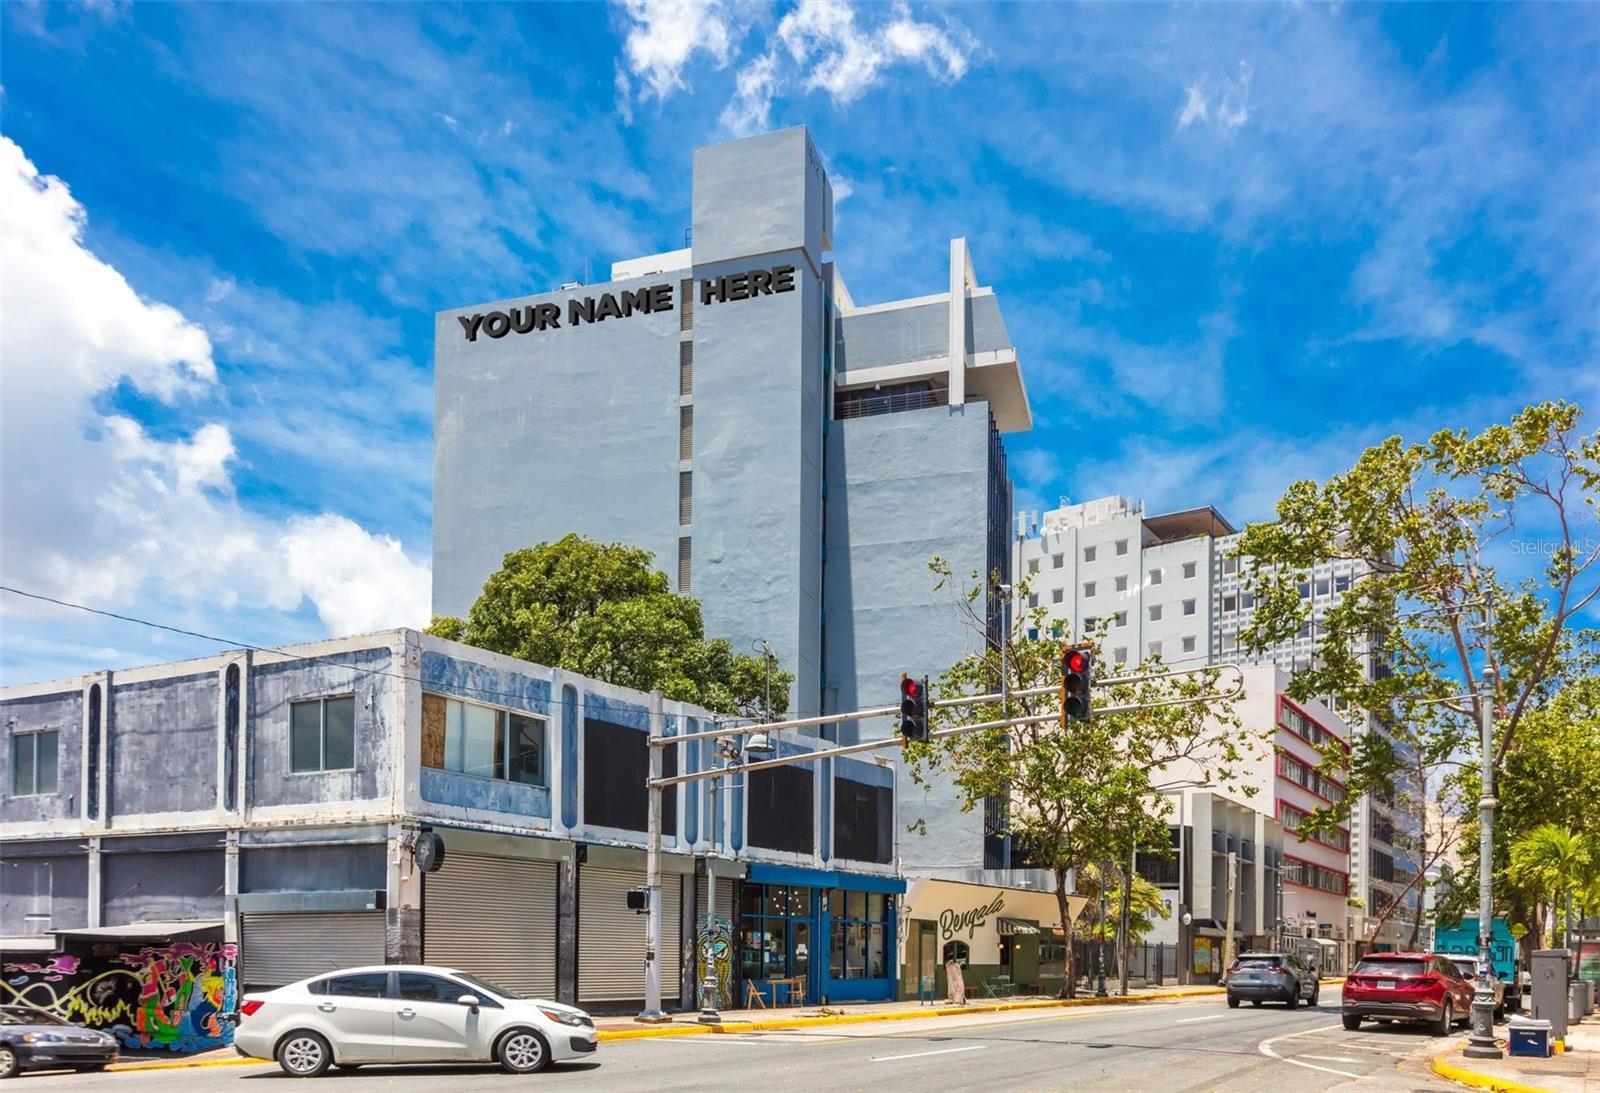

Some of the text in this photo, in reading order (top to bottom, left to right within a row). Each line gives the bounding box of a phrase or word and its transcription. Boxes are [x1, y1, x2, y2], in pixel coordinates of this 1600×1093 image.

[457, 264, 796, 342] YOUR NAME HERE
[939, 891, 1005, 940] Bengala
